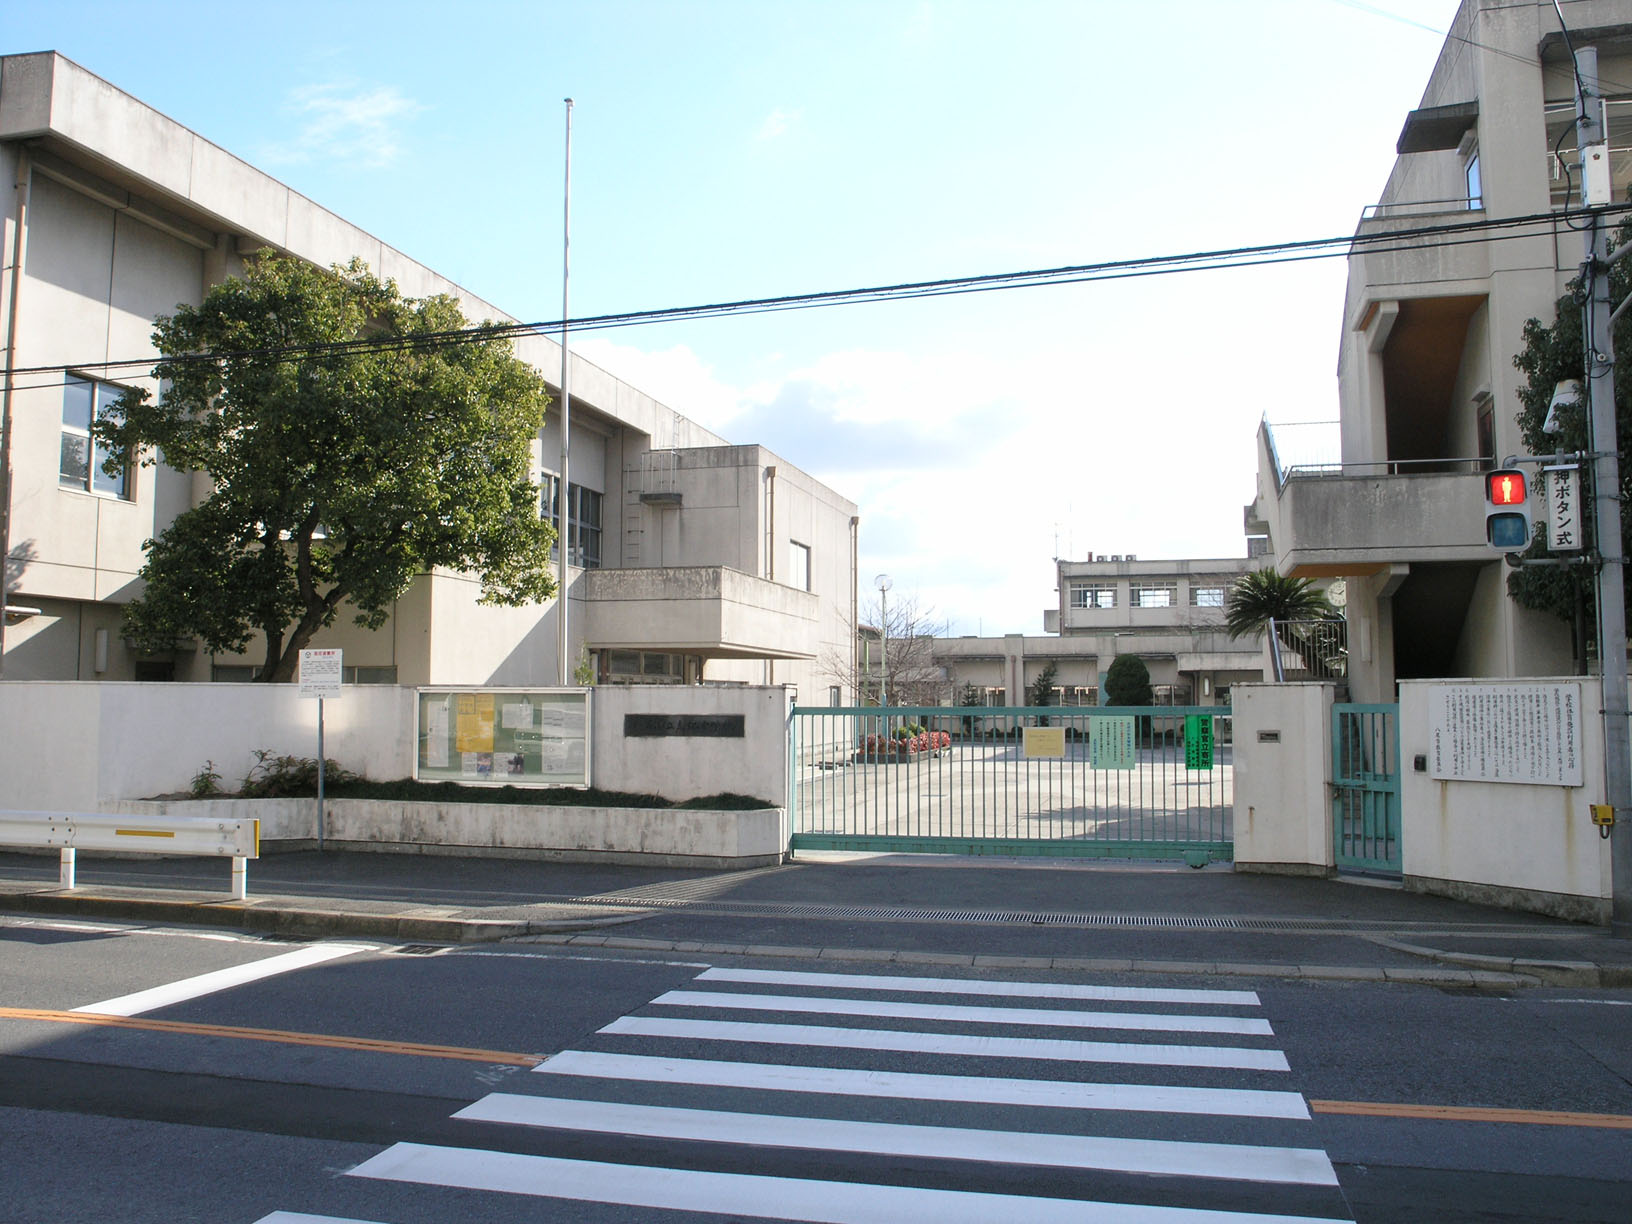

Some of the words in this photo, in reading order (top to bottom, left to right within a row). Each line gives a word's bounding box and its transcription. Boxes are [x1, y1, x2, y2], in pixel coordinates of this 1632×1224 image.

[1553, 470, 1573, 546] 押ボタン式
[1200, 718, 1210, 768] 警察官立寄所
